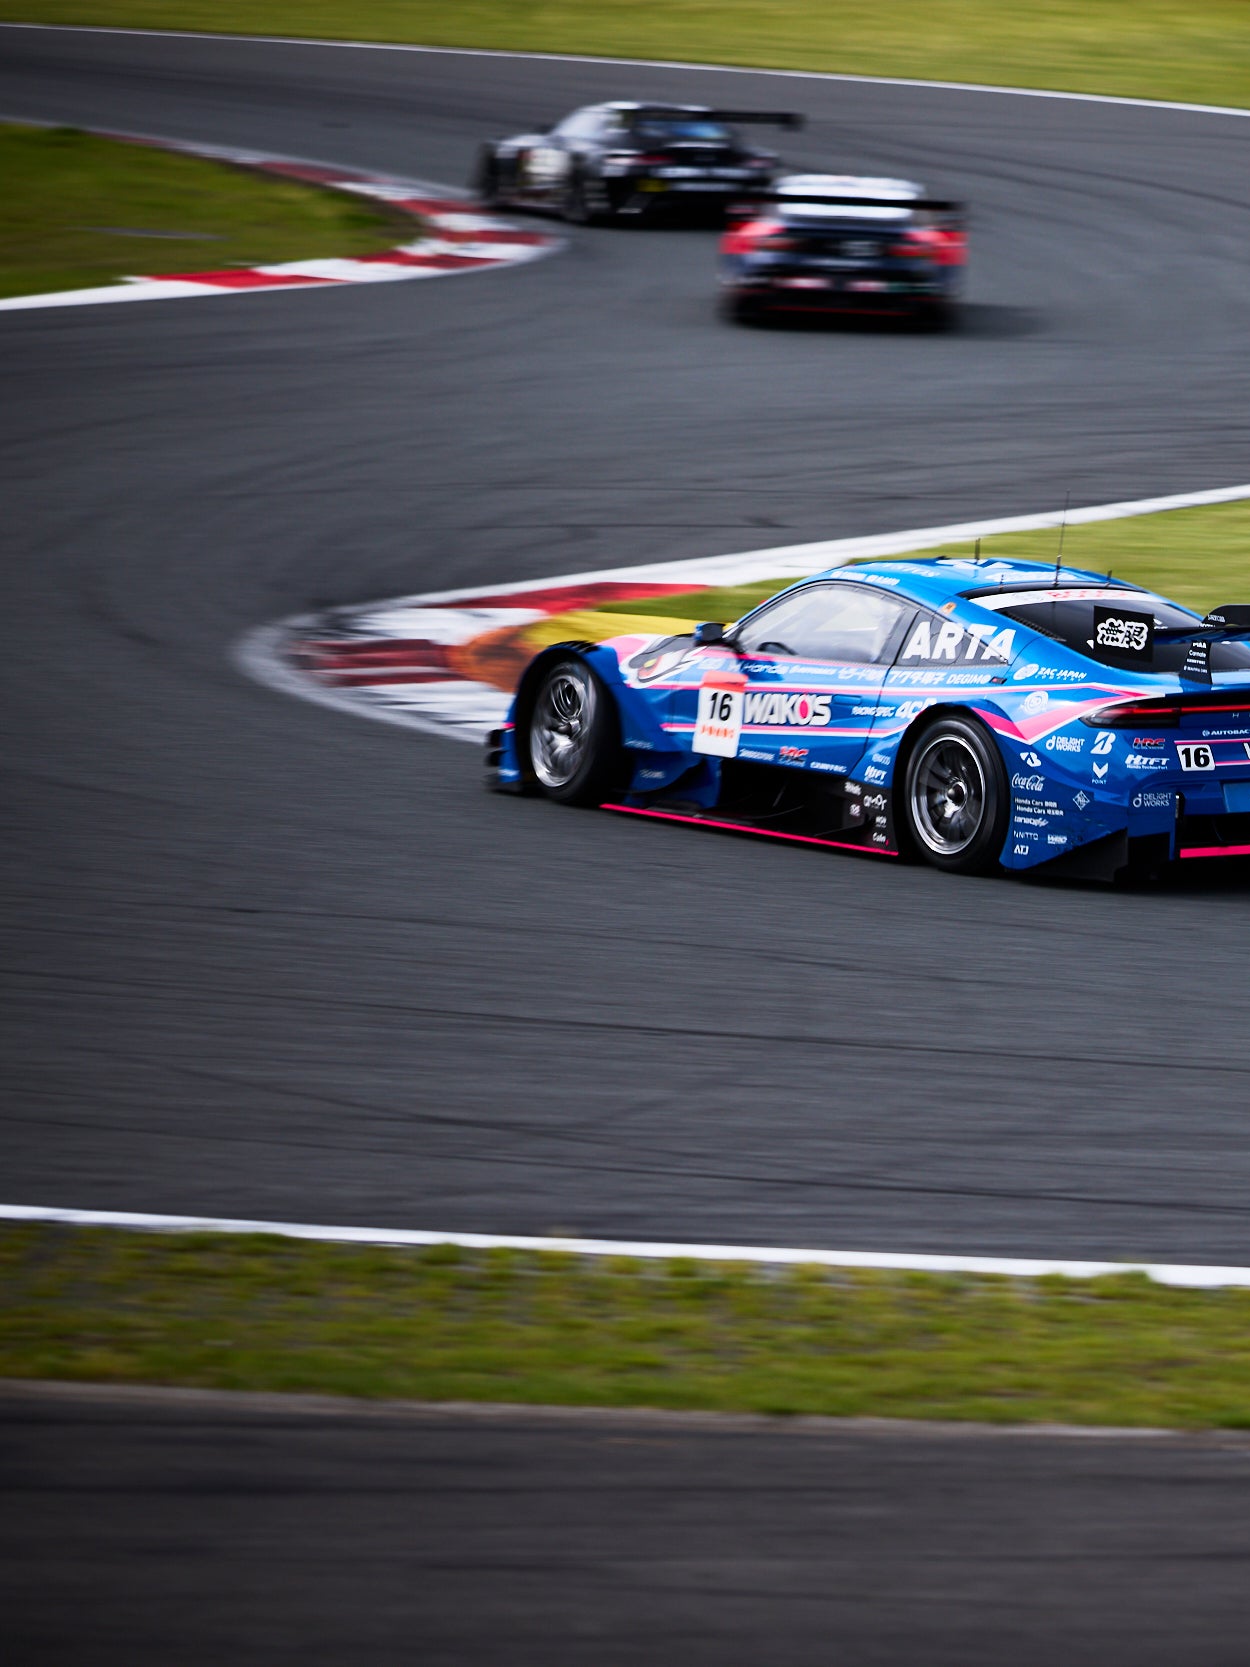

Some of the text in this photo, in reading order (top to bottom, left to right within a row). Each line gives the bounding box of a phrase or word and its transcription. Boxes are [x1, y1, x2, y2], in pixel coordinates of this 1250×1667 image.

[902, 621, 1016, 661] ARTA
[709, 691, 733, 722] 16
[1181, 747, 1211, 768] 16
[1014, 797, 1031, 806] Honda
[1016, 805, 1034, 814] Honda
[1033, 807, 1046, 815] Cars
